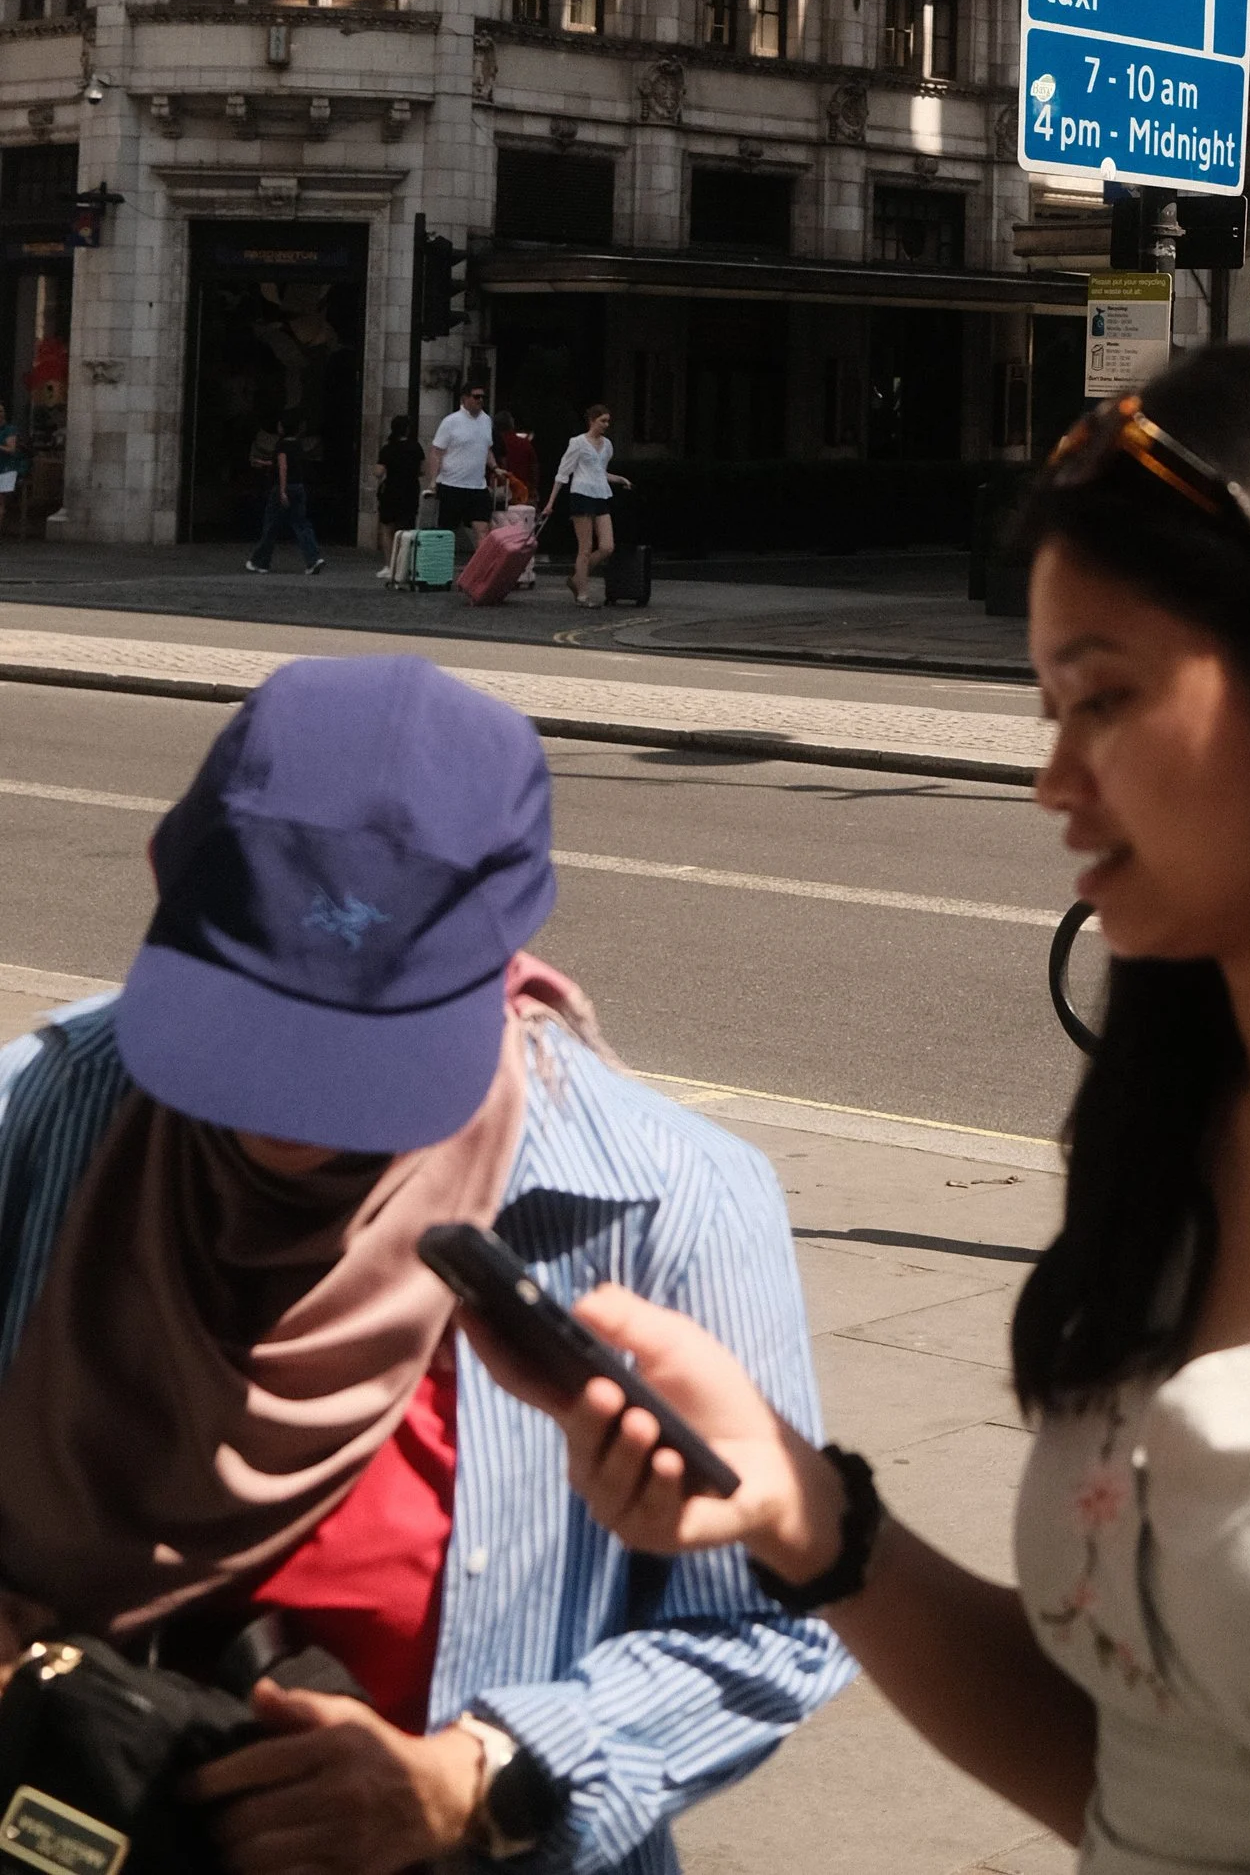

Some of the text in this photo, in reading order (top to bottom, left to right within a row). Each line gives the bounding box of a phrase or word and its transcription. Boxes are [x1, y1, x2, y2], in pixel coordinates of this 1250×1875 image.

[1084, 56, 1100, 93] 7
[1033, 104, 1054, 141] 4
[1060, 116, 1100, 151] pm
[1129, 116, 1236, 171] Midnight
